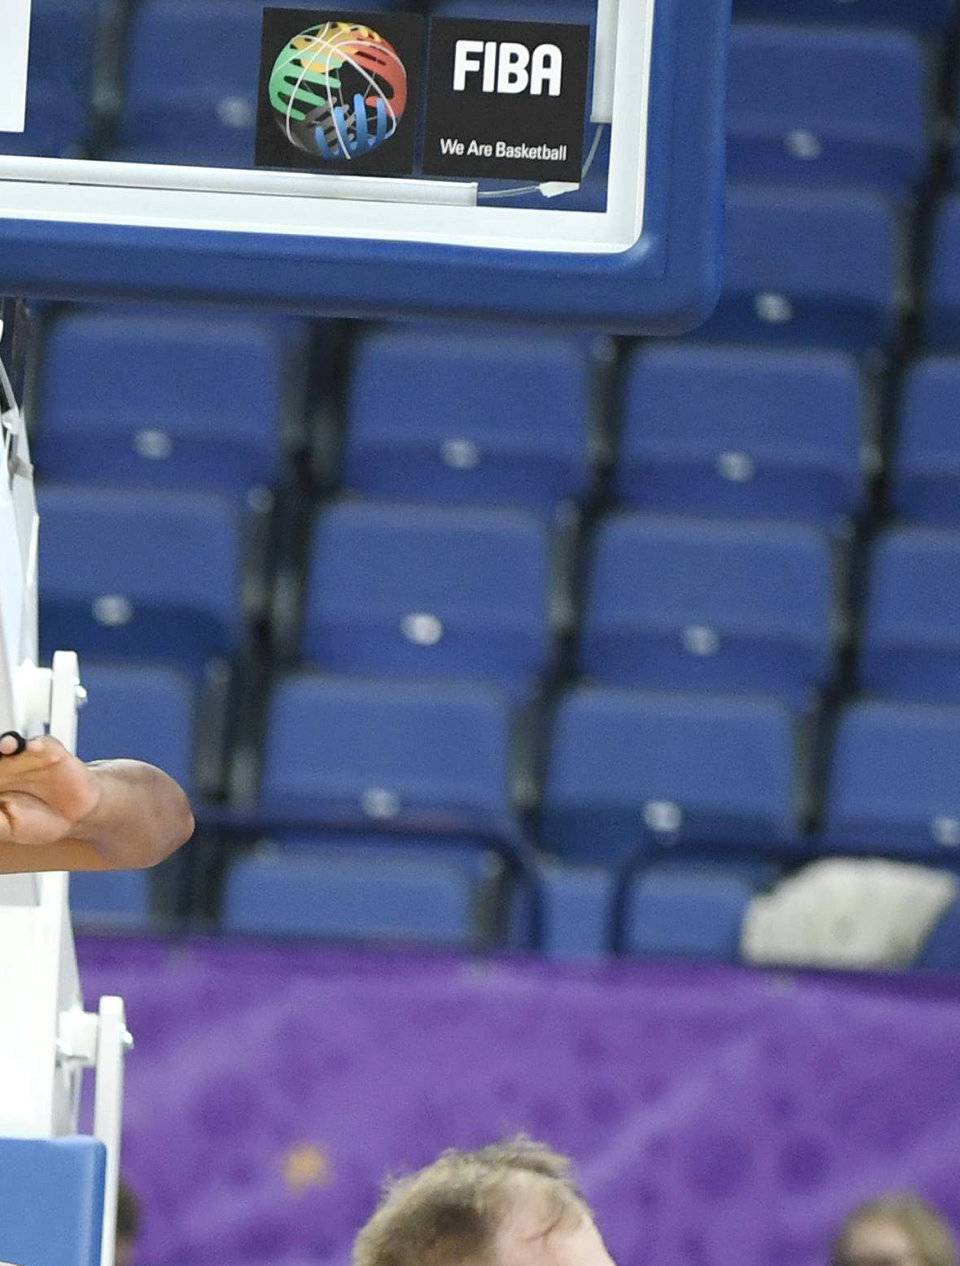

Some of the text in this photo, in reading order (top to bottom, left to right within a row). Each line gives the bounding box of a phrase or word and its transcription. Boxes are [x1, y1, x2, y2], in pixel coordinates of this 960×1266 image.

[452, 39, 563, 97] FIBA
[439, 138, 568, 162] We Are Basketball
